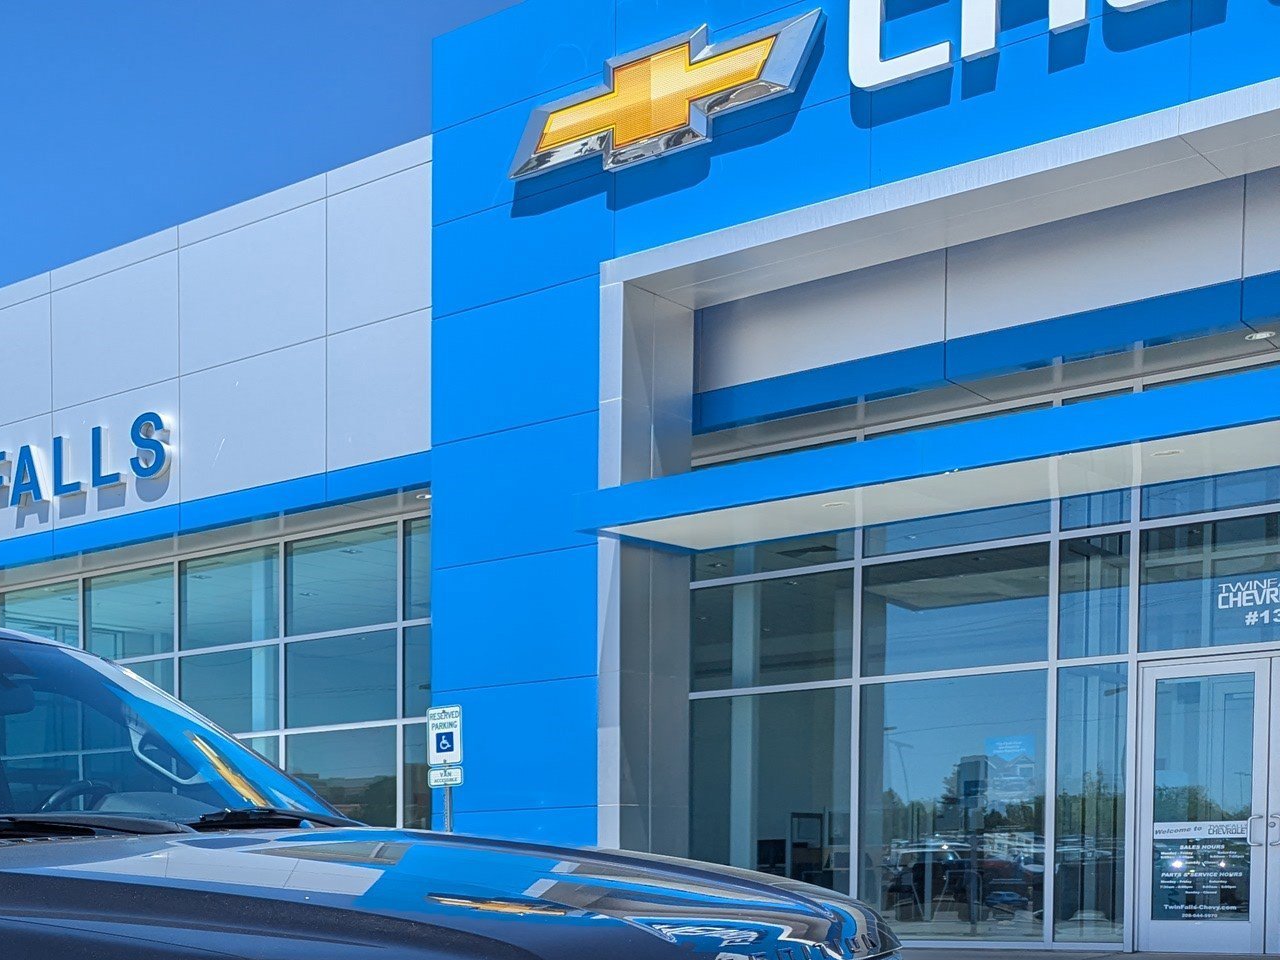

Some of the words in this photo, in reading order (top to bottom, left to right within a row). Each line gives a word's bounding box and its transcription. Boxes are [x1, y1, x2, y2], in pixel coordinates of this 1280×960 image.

[1218, 577, 1280, 594] TWINF
[1218, 588, 1280, 610] CHEVR
[429, 710, 460, 721] RESERVED
[431, 720, 458, 731] PARKING
[439, 770, 452, 778] VAN
[1155, 827, 1191, 836] Welcome
